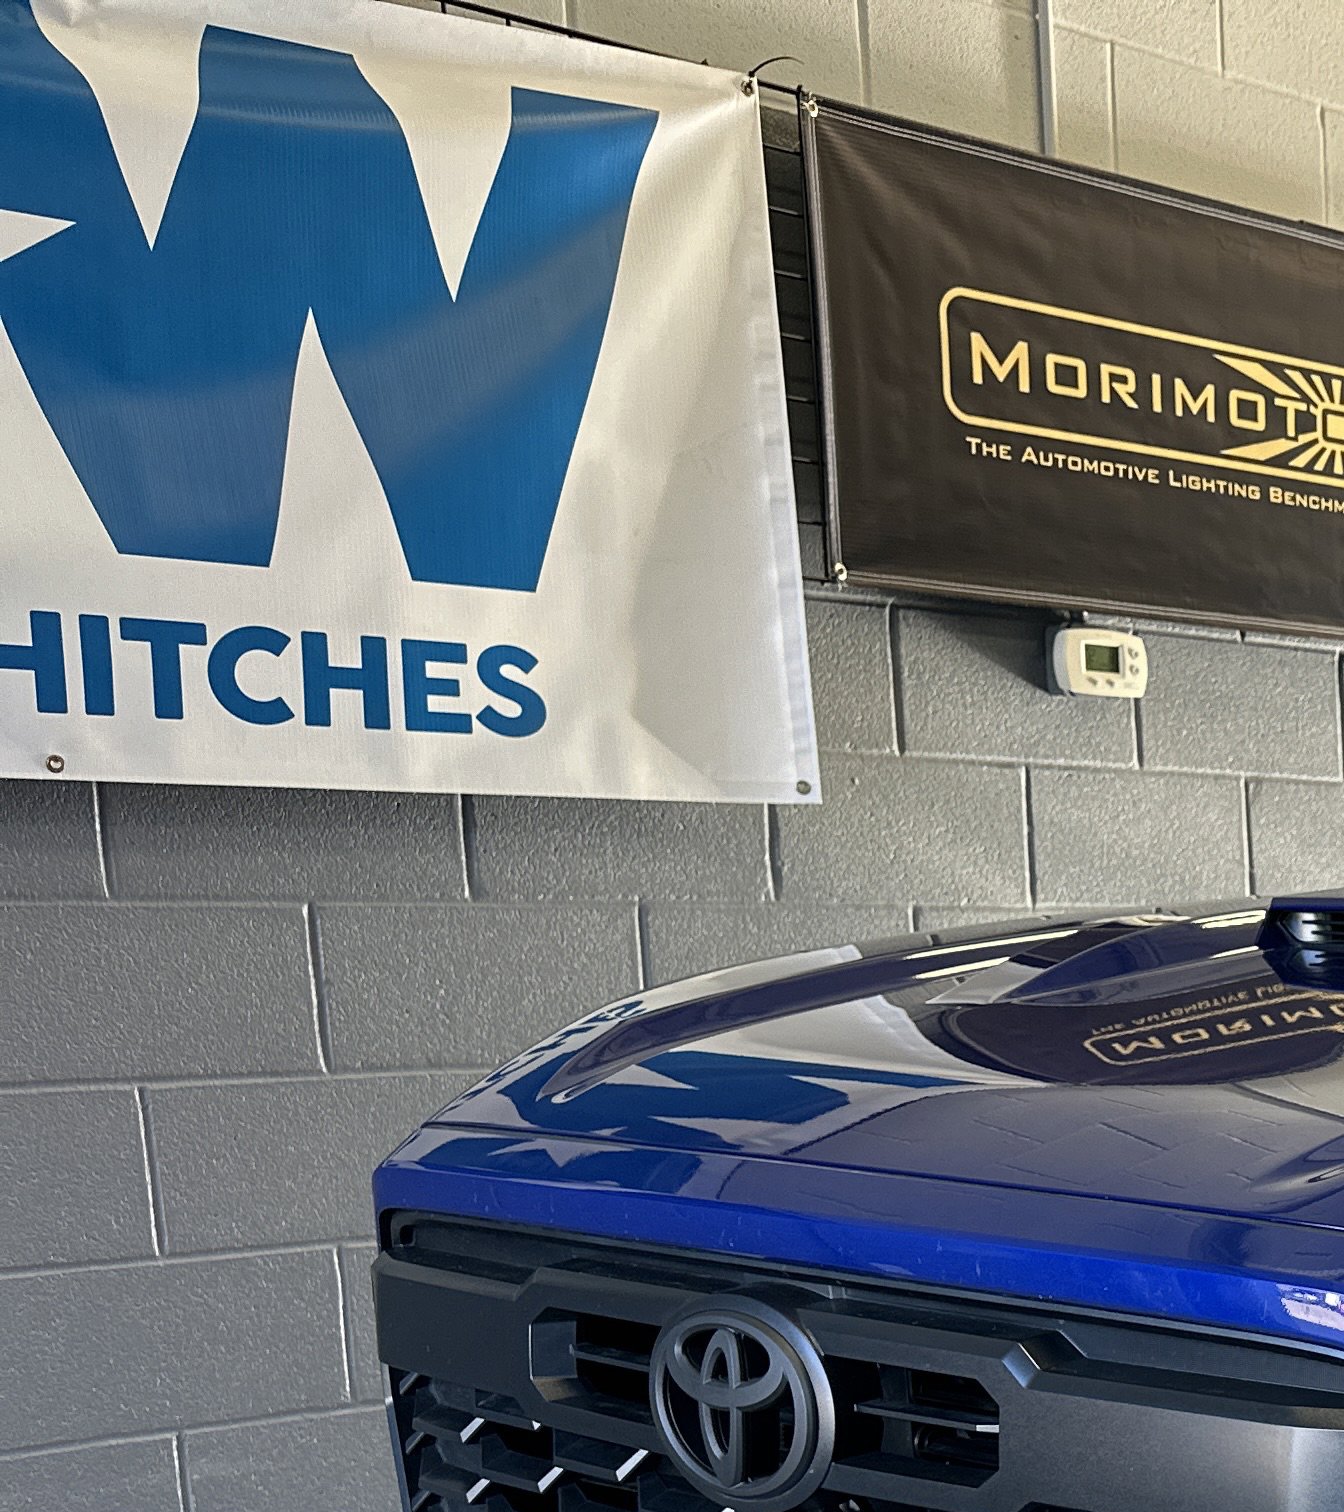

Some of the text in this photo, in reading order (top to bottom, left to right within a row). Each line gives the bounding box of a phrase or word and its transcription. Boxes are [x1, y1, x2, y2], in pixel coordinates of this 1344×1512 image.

[965, 435, 1012, 462] THE
[1021, 445, 1160, 486] AUTOMOTIVE
[1168, 469, 1261, 502] LIGHTING
[0, 610, 547, 738] HITCHES
